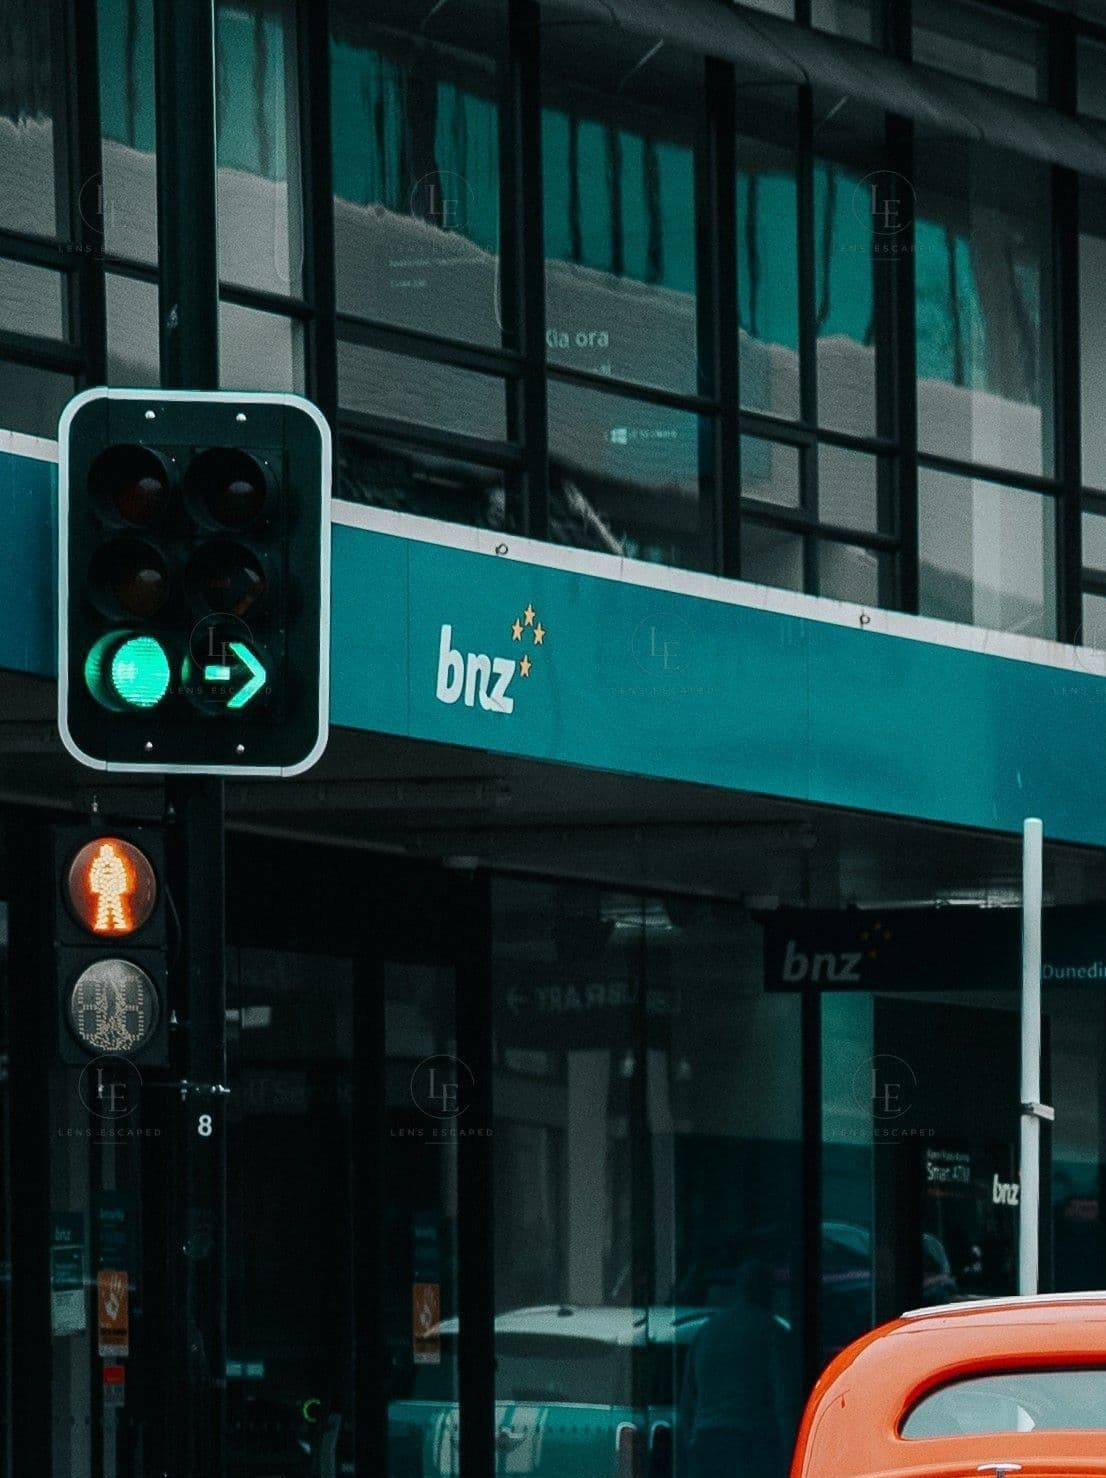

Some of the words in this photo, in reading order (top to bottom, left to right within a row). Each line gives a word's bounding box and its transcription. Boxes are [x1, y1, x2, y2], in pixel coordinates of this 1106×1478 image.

[436, 624, 516, 714] bnz
[782, 939, 863, 982] bnz
[197, 1114, 213, 1137] 8
[992, 1172, 1019, 1206] bnz
